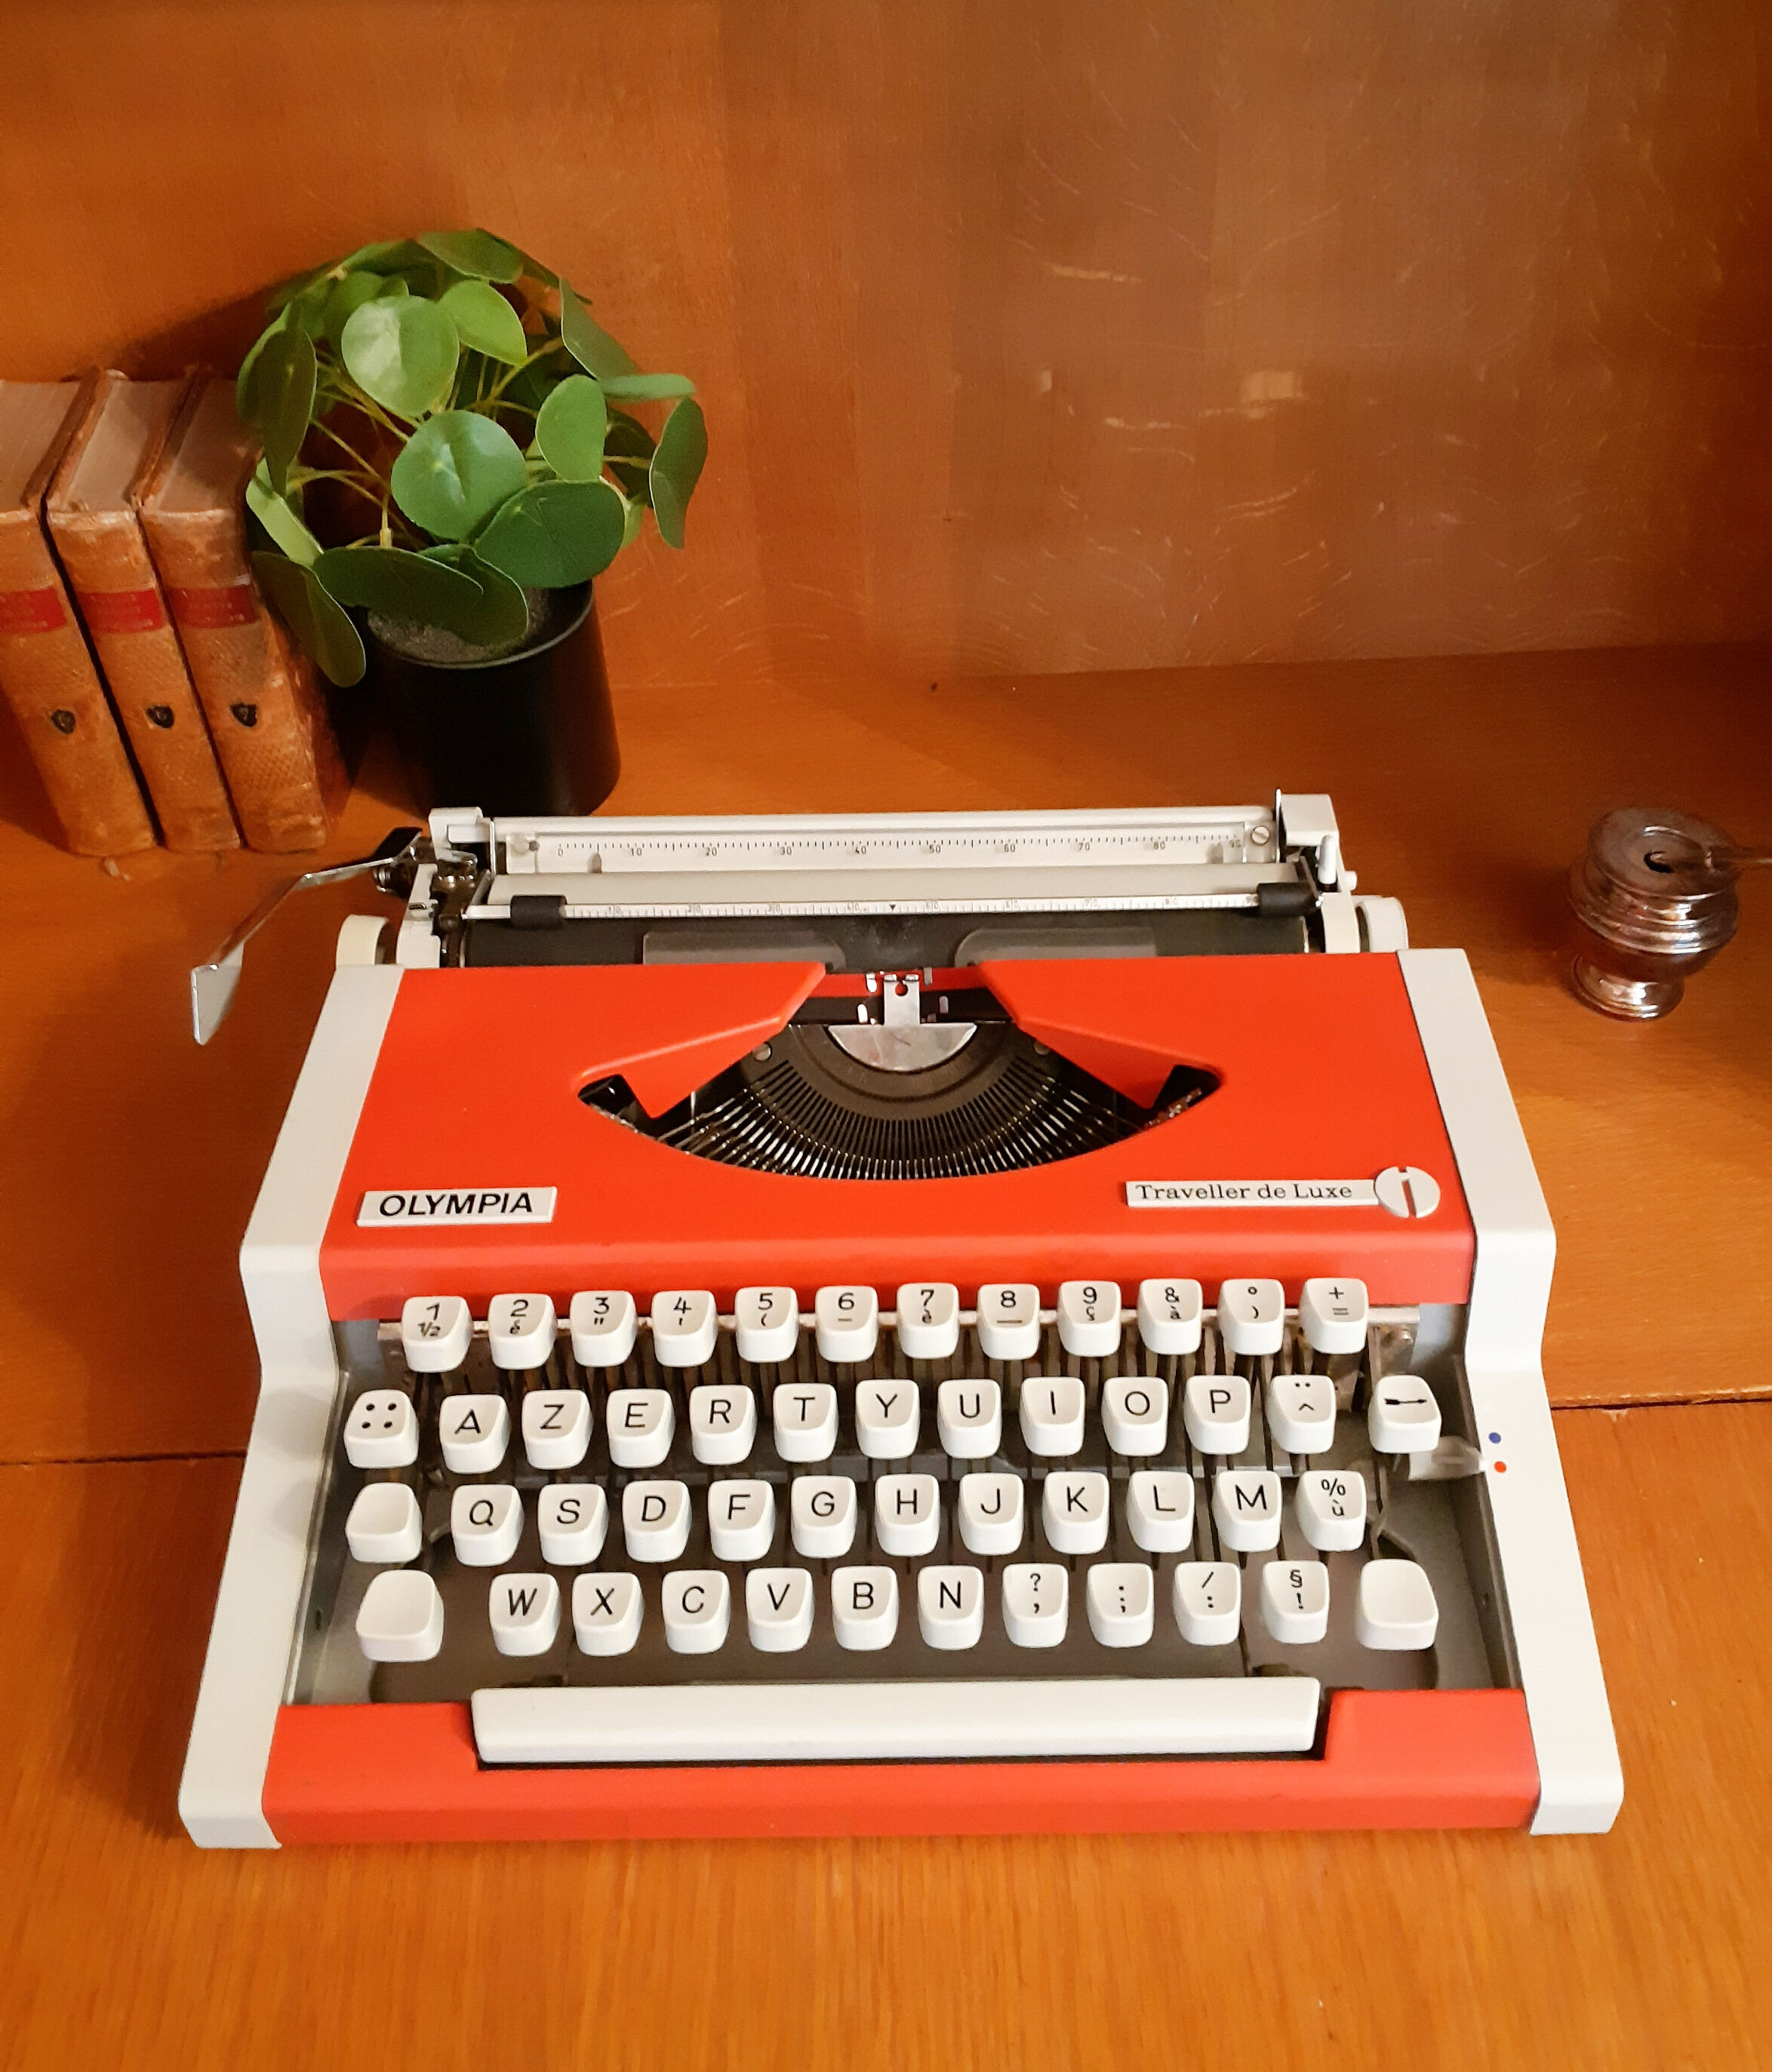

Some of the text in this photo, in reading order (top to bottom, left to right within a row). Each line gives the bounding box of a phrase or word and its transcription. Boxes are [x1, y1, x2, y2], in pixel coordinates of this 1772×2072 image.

[631, 848, 642, 856] 10
[706, 847, 717, 856] 20
[781, 847, 792, 856] 30
[855, 846, 866, 855] 40
[929, 844, 941, 853] 50
[1004, 844, 1016, 853] 60
[1078, 842, 1091, 851] 70
[1153, 841, 1165, 850] 80
[1139, 1183, 1352, 1199] Traveller de Luxe
[379, 1192, 533, 1217] OLYMPIA
[593, 1296, 610, 1315] 3
[673, 1296, 692, 1314] 4
[758, 1293, 774, 1311] 5
[838, 1293, 854, 1311] 6
[920, 1289, 934, 1307] 7
[1000, 1290, 1017, 1308] 8
[1083, 1287, 1097, 1305] 9
[1164, 1287, 1180, 1303] &
[1329, 1287, 1344, 1299] +
[426, 1303, 440, 1321] 1
[510, 1299, 529, 1317] 2
[1170, 1305, 1182, 1320] à
[709, 1399, 732, 1425] R
[793, 1397, 816, 1422] T
[875, 1394, 898, 1419] Y
[959, 1394, 980, 1419] U
[1050, 1391, 1057, 1416] I
[1124, 1391, 1150, 1416] O
[1209, 1389, 1232, 1414] P
[454, 1410, 481, 1435] A
[540, 1403, 565, 1430] Z
[624, 1403, 648, 1428] E
[1153, 1485, 1176, 1512] L
[1235, 1484, 1267, 1511] M
[1321, 1477, 1346, 1496] %
[556, 1499, 580, 1525] S
[641, 1496, 666, 1522] D
[728, 1494, 751, 1520] F
[811, 1491, 835, 1517] G
[897, 1488, 918, 1515] H
[980, 1488, 1001, 1515] J
[1066, 1486, 1088, 1513] K
[1331, 1499, 1345, 1517] ù
[469, 1499, 494, 1526] Q
[1029, 1572, 1041, 1591] ?
[508, 1588, 537, 1616] W
[590, 1588, 615, 1616] X
[681, 1585, 705, 1614] C
[767, 1583, 790, 1611] V
[852, 1582, 874, 1609] B
[940, 1581, 961, 1609] N
[1297, 1592, 1304, 1609] !
